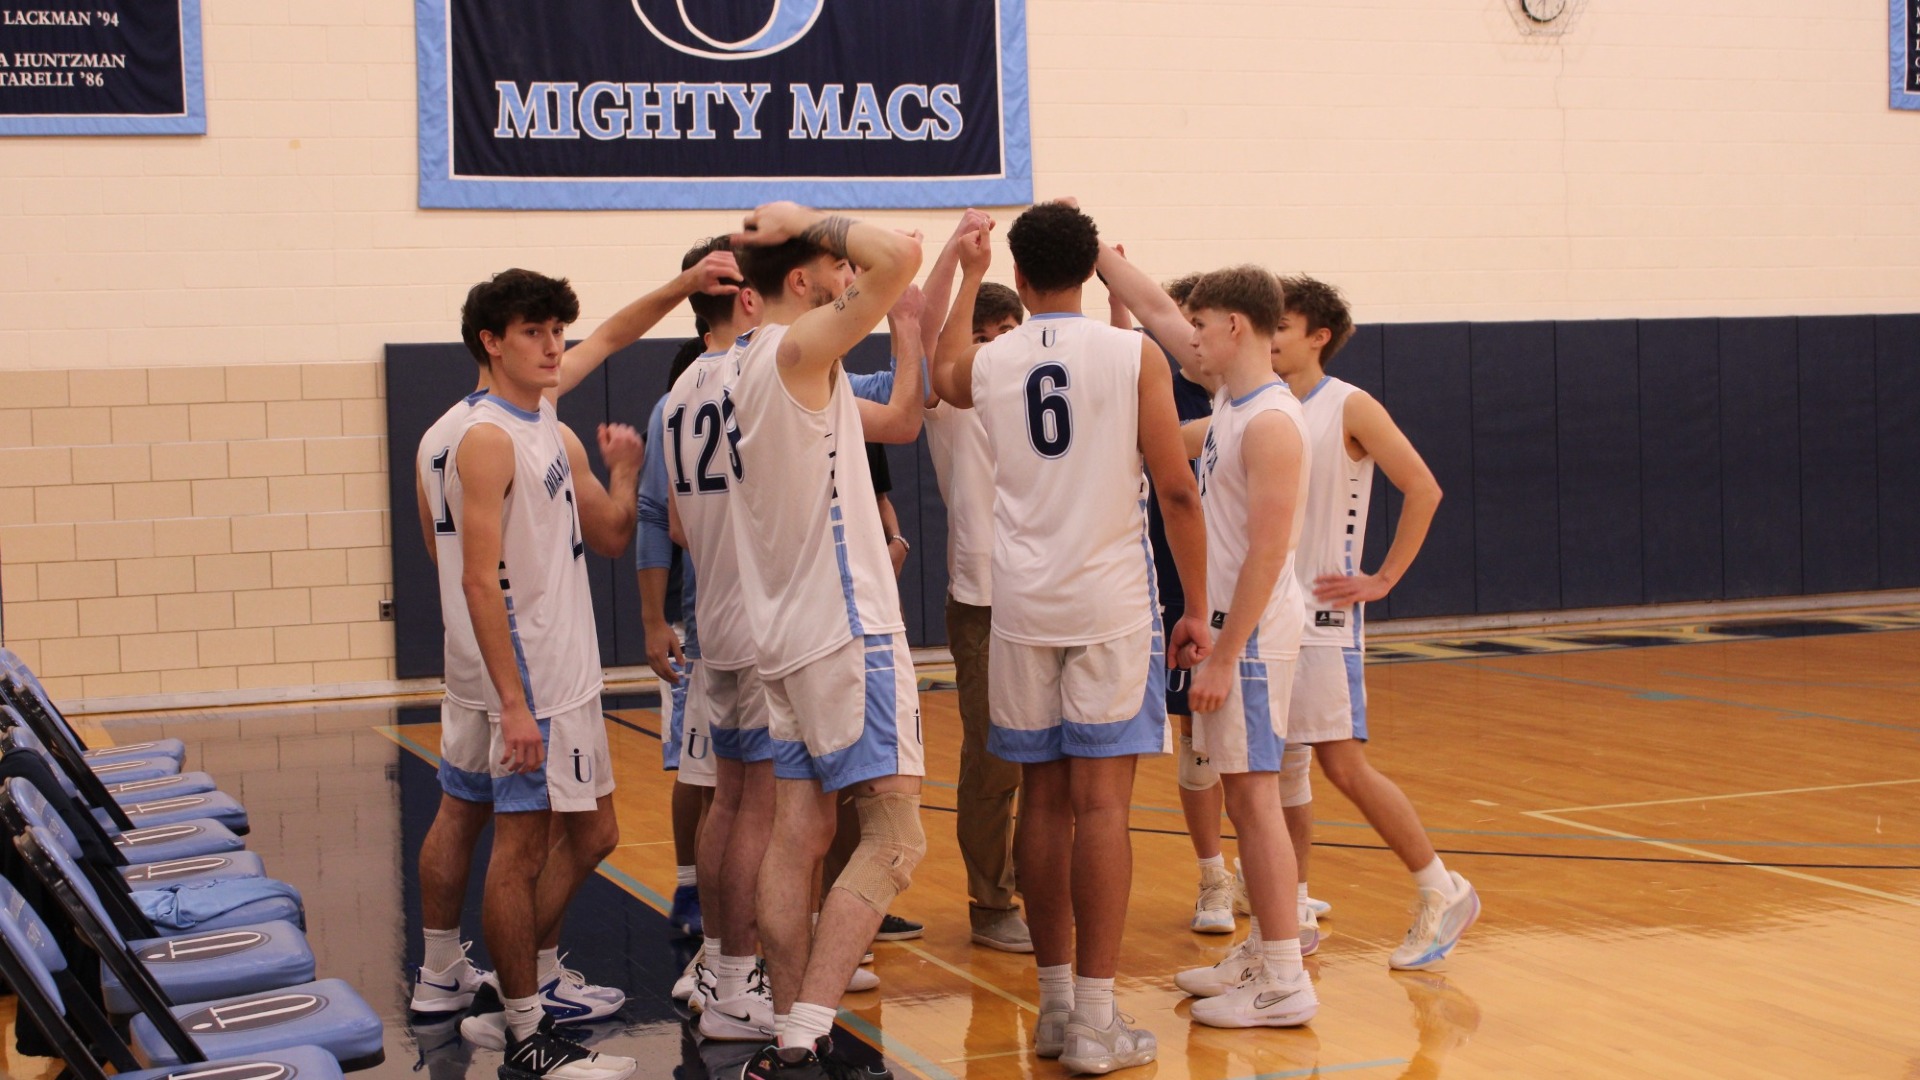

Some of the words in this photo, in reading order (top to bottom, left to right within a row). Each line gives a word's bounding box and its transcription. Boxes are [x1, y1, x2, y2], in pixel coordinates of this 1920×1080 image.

[3, 10, 91, 26] LACKMAN
[14, 53, 126, 69] HUNTZMAN
[80, 72, 104, 87] '86
[494, 80, 771, 140] MIGHTY
[788, 82, 963, 141] MACS
[1023, 361, 1073, 460] 6
